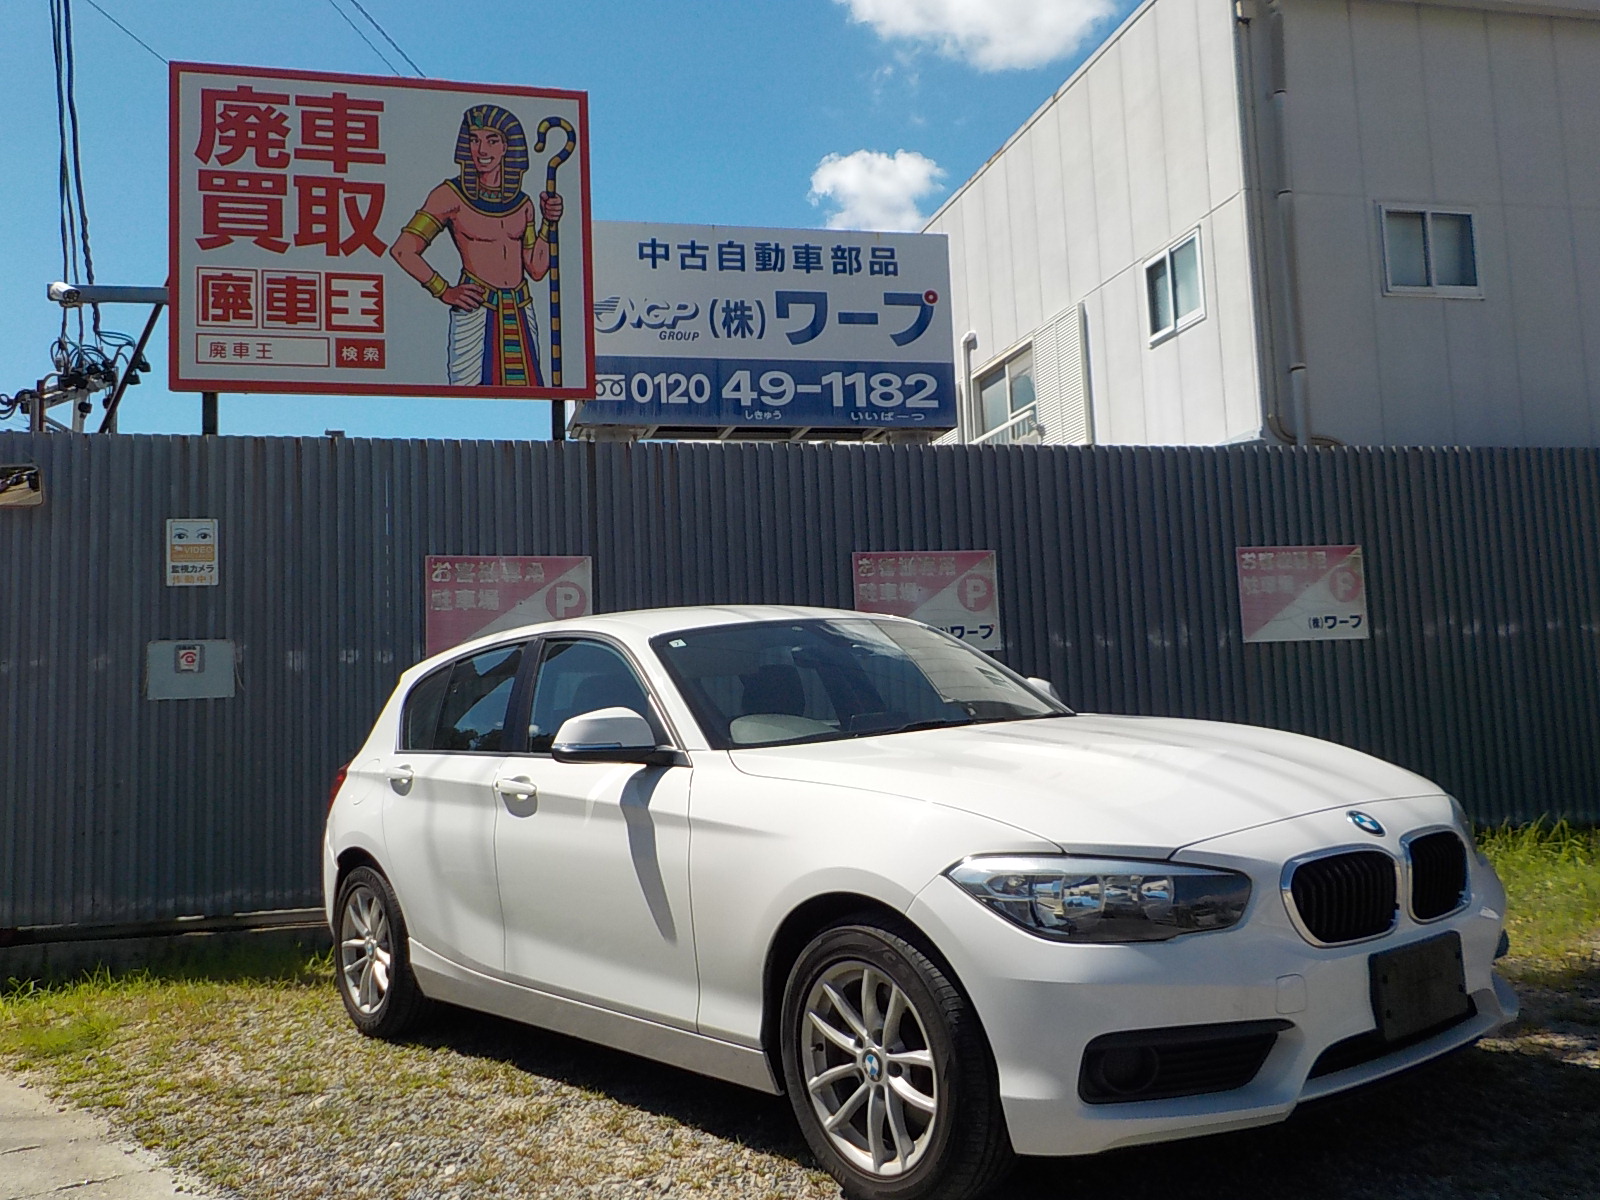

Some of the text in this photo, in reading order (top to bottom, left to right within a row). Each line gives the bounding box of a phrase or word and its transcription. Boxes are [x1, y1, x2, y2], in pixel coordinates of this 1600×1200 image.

[194, 85, 386, 173] 廃車
[195, 168, 388, 258] 買取
[638, 238, 899, 276] 中古自動車部品
[201, 272, 382, 329] 廃車王
[708, 290, 939, 347] (株)ワープ
[209, 341, 274, 360] 廃車王
[659, 330, 700, 342] GROUP
[341, 346, 380, 362] 検索
[631, 370, 939, 408] 0120 49-1182
[745, 410, 782, 420] しきゅう
[184, 545, 213, 554] VIDEO
[171, 564, 215, 574] 監視カメラ
[966, 578, 987, 608] P
[1336, 571, 1355, 599] P
[556, 586, 580, 618] P
